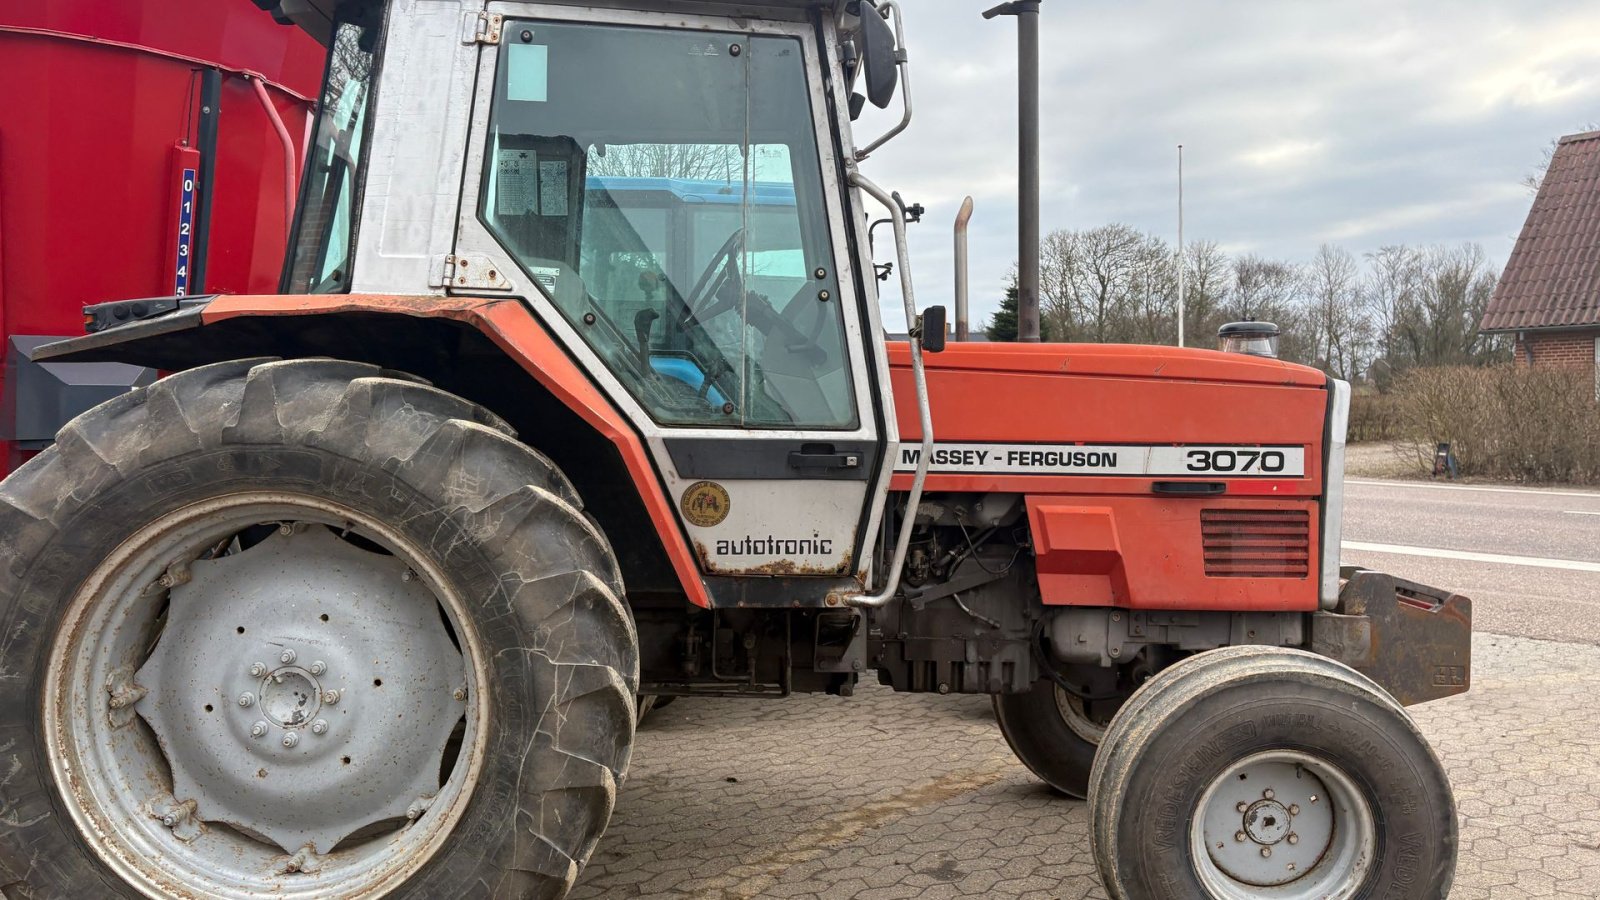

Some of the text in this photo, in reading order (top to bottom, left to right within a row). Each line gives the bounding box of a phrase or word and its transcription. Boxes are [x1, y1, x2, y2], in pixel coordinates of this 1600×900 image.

[184, 179, 193, 192] 0
[183, 202, 191, 214] 1
[180, 223, 190, 235] 2
[179, 244, 188, 256] 3
[177, 266, 187, 278] 4
[176, 286, 185, 297] 5
[1007, 450, 1117, 468] FERGUSON
[1186, 450, 1285, 472] 3070
[716, 535, 832, 555] autotronic
